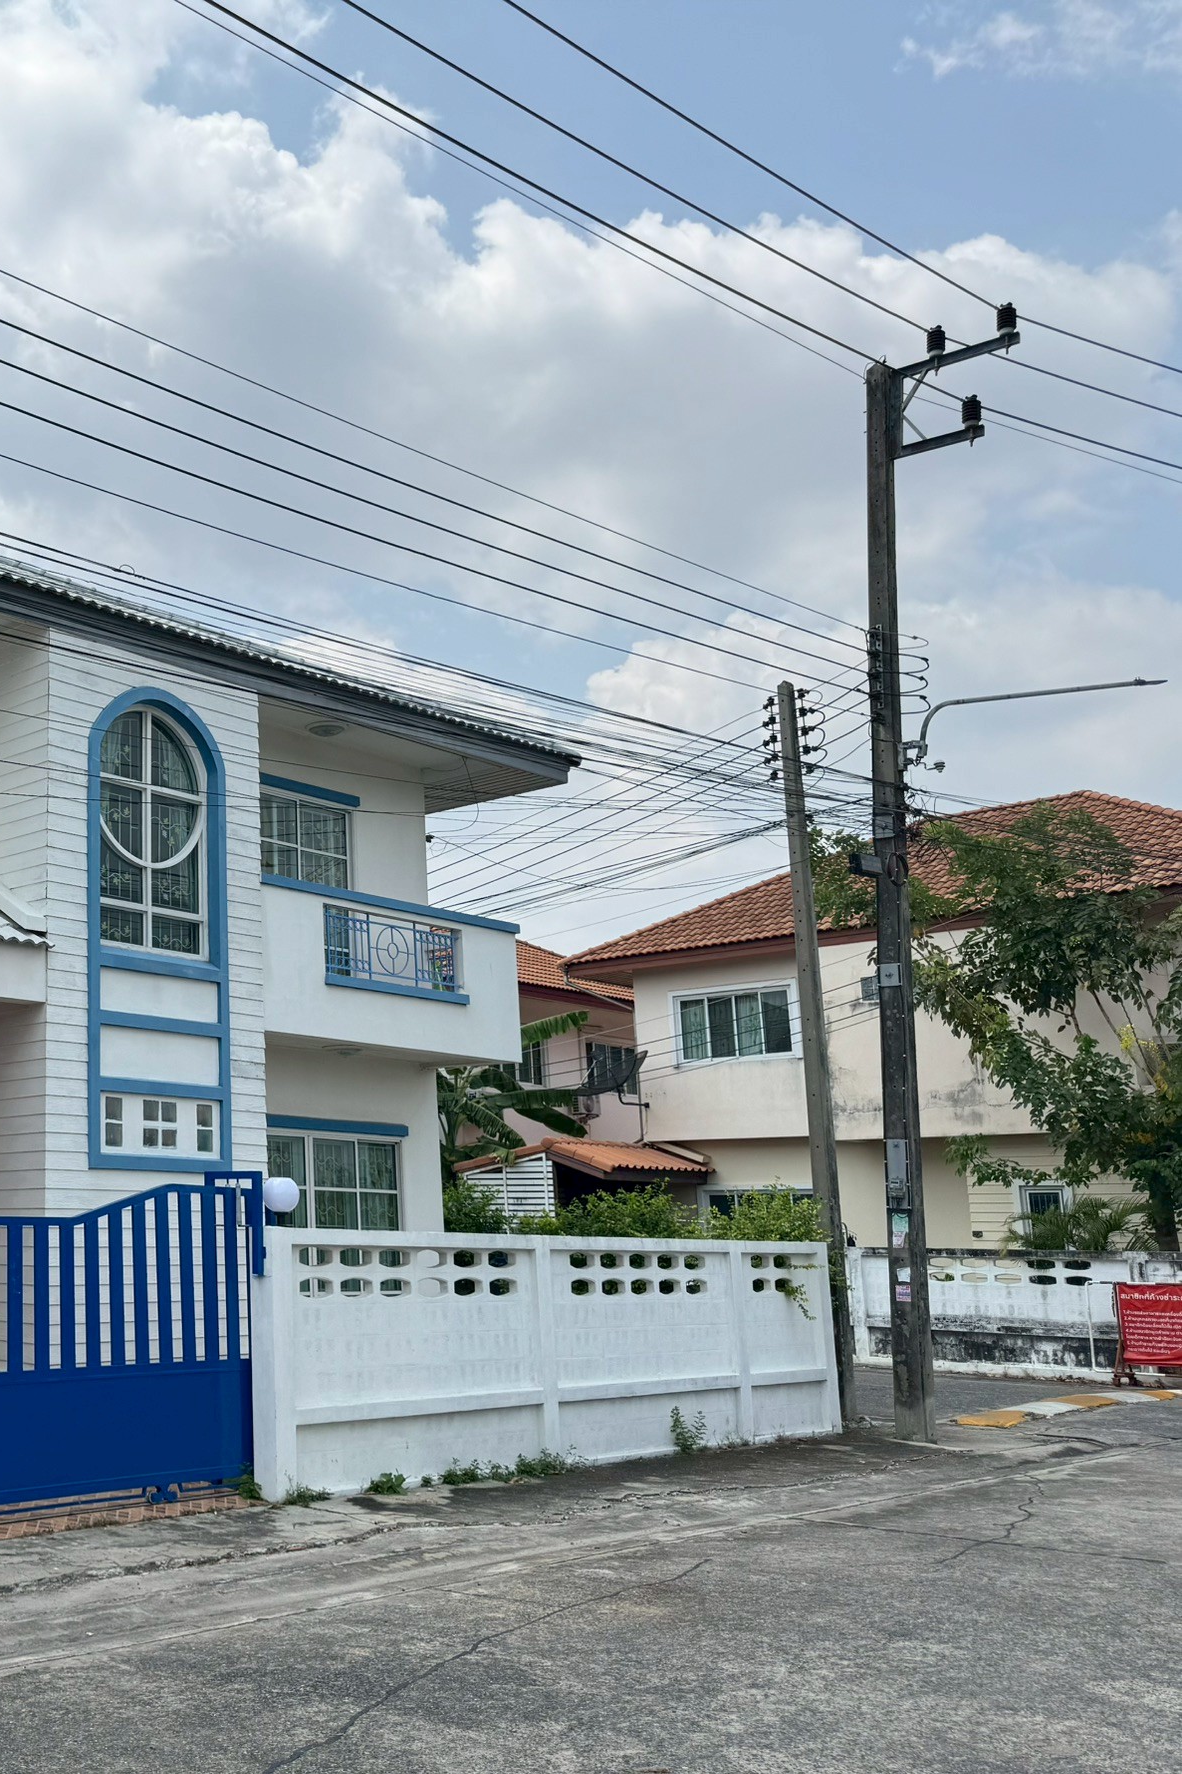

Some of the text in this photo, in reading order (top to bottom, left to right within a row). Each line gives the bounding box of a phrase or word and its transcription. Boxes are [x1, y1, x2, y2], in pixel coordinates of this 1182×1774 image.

[1120, 1291, 1182, 1301] สมาชิกที่ค้างชำระ
